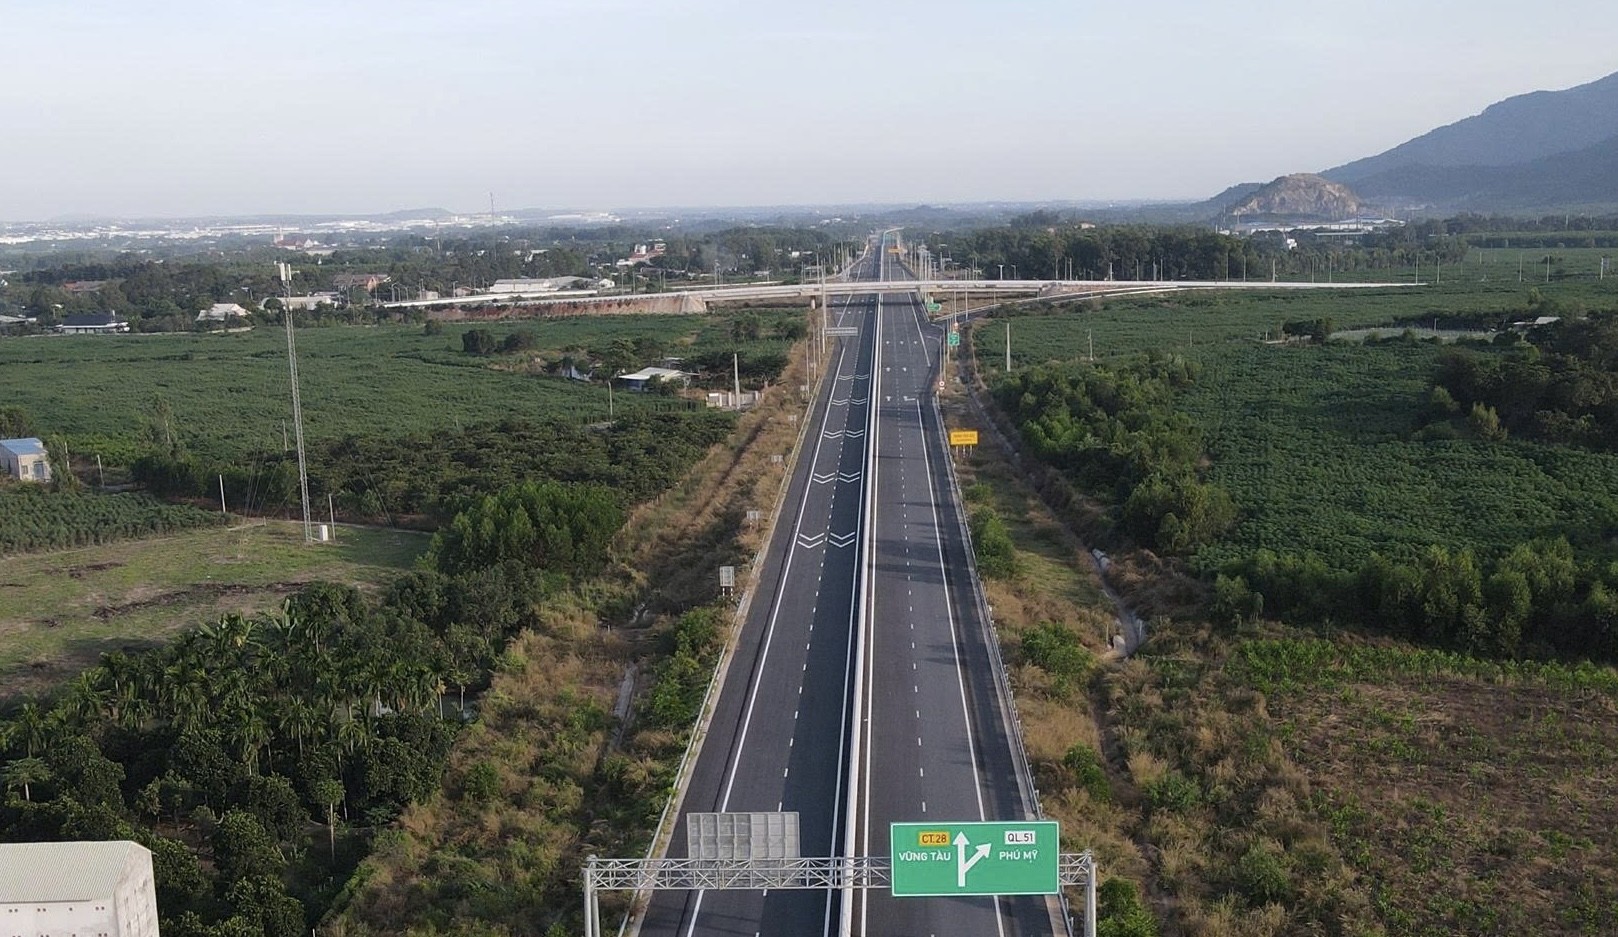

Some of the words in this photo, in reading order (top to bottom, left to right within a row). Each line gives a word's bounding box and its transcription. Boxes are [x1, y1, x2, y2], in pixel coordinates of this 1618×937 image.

[1007, 832, 1034, 843] QL.51
[929, 849, 951, 861] TÀU
[999, 849, 1021, 860] PHÚ
